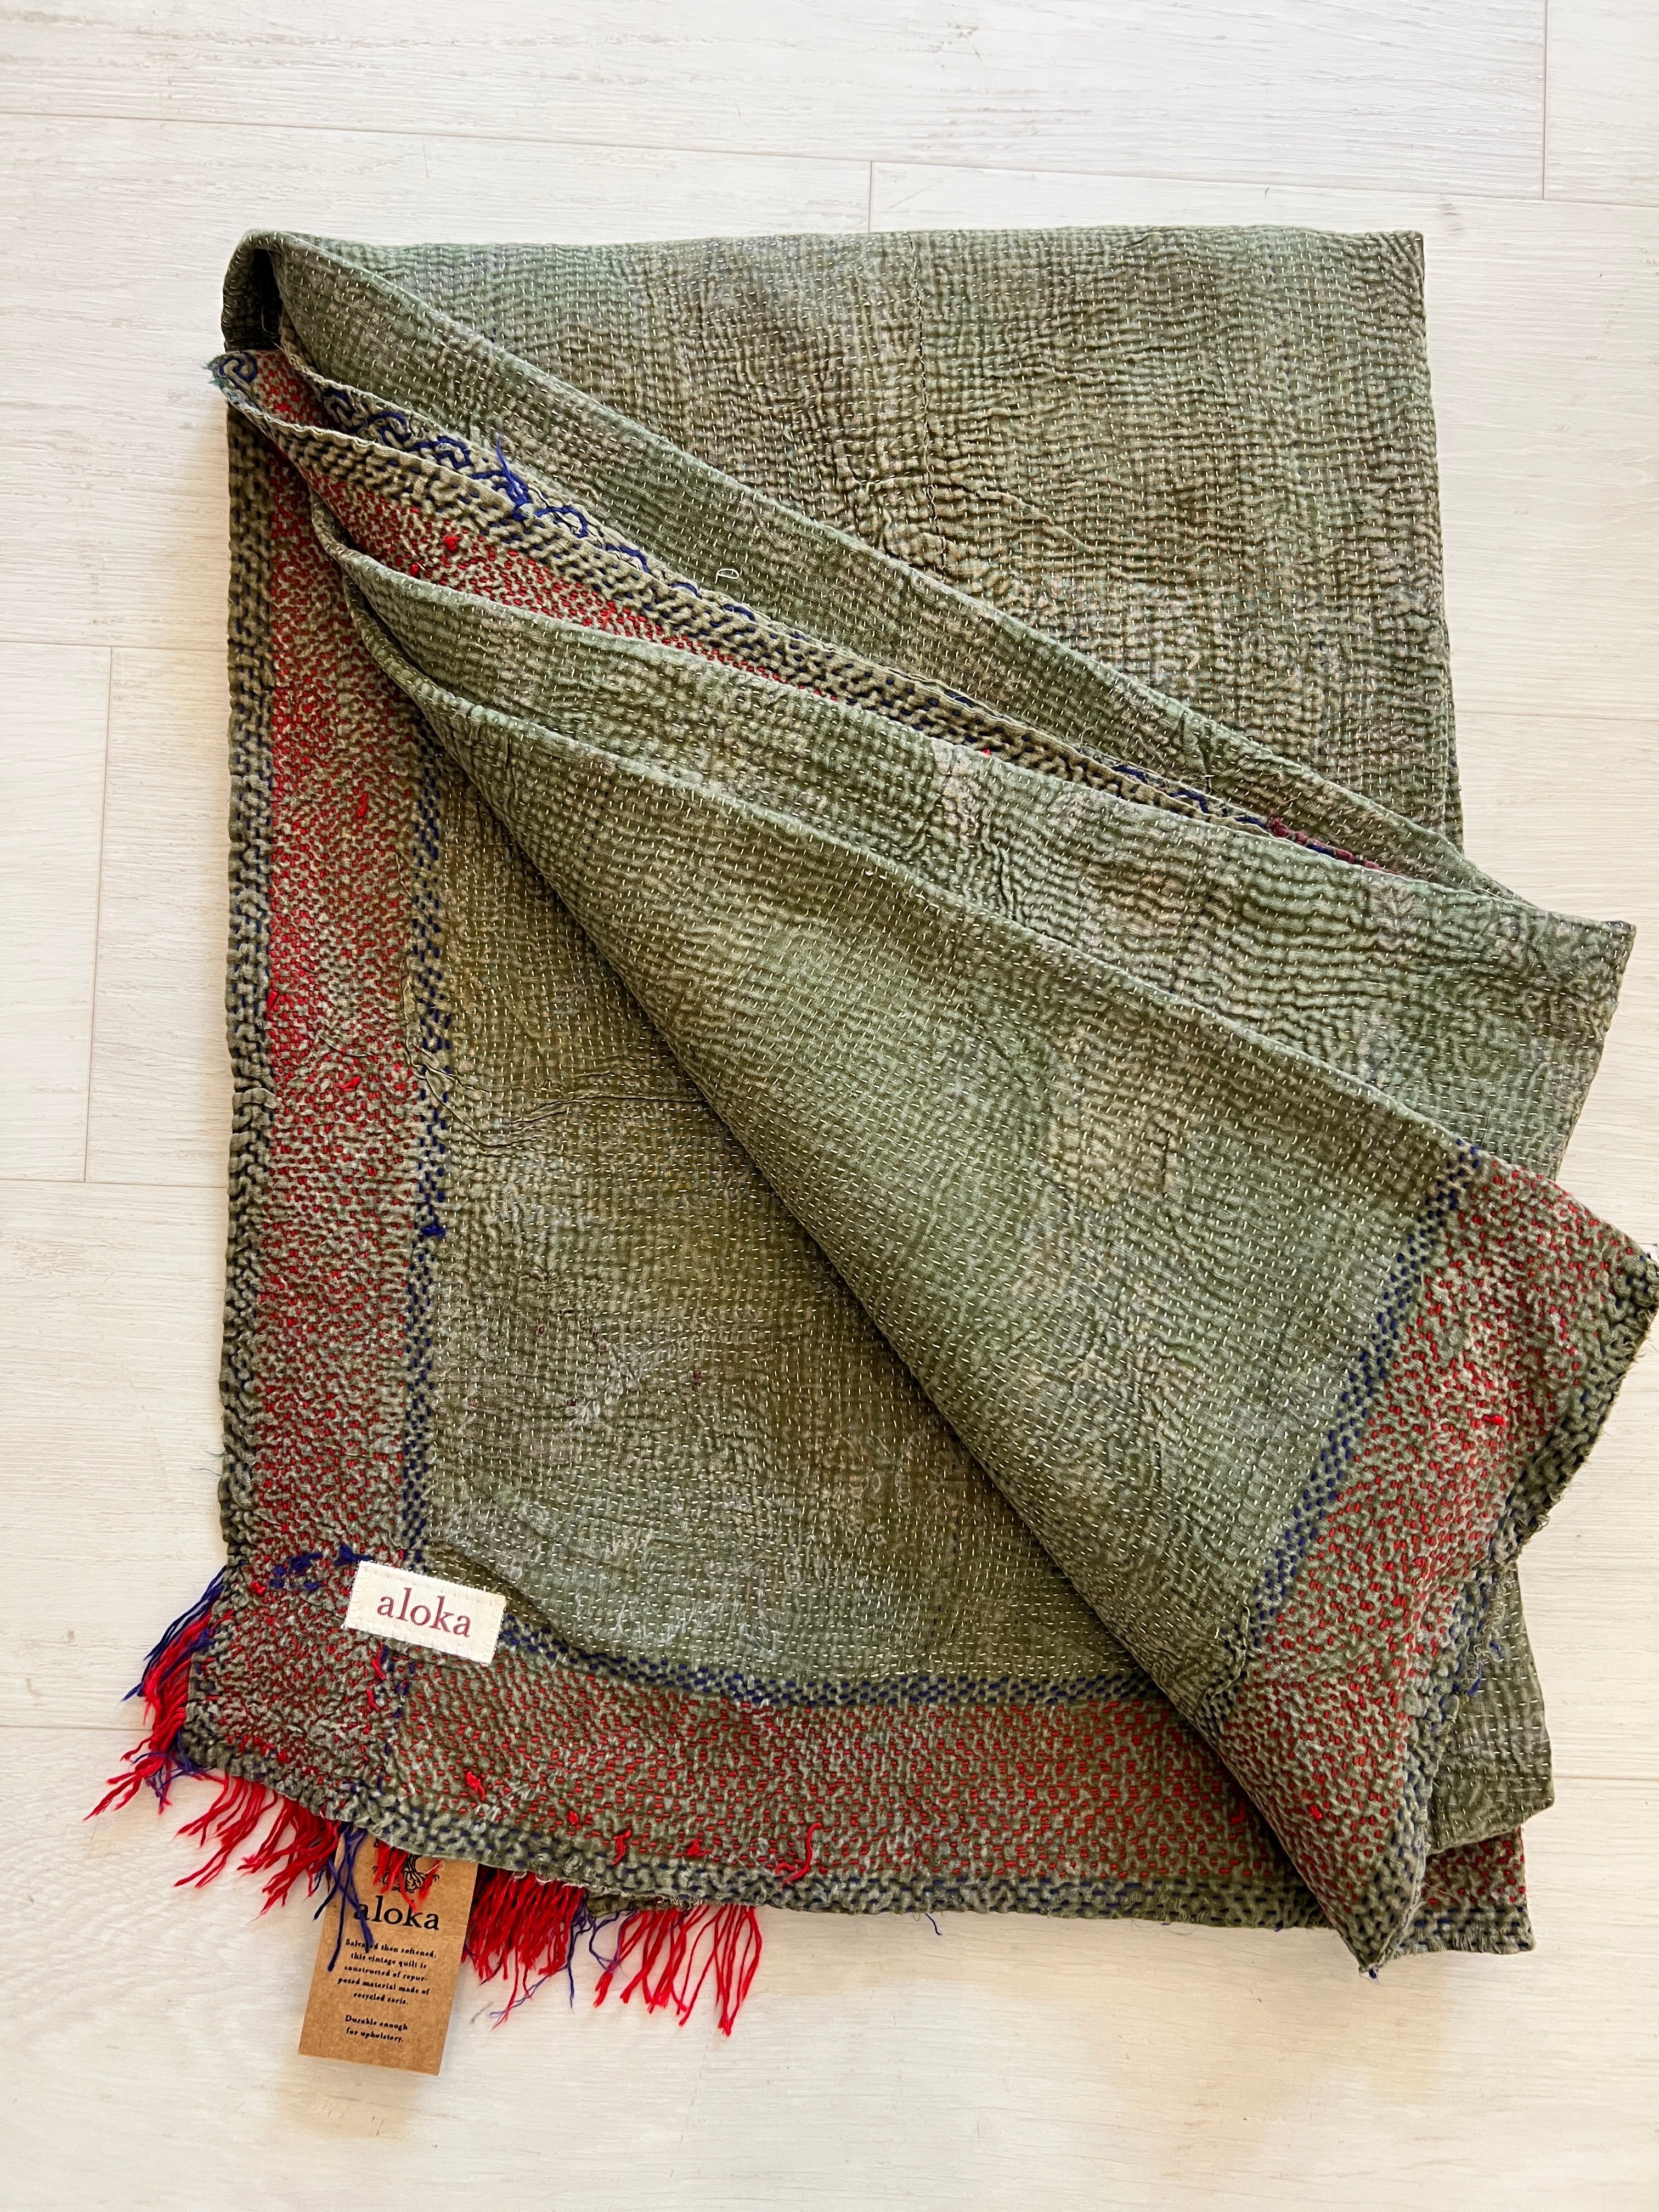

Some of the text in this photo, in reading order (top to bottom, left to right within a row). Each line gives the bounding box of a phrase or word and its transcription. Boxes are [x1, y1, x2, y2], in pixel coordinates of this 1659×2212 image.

[377, 1587, 471, 1638] aloka
[353, 1895, 439, 1931] aloka
[346, 1938, 436, 1958] Salvaed then softened,
[351, 1952, 366, 1960] this
[368, 1955, 396, 1966] vintage
[345, 1966, 390, 1976] constructed
[363, 1981, 396, 1990] material
[353, 1993, 385, 2001] recycled
[345, 2015, 408, 2032] Durable enough
[346, 2027, 403, 2044] for upholstery.
